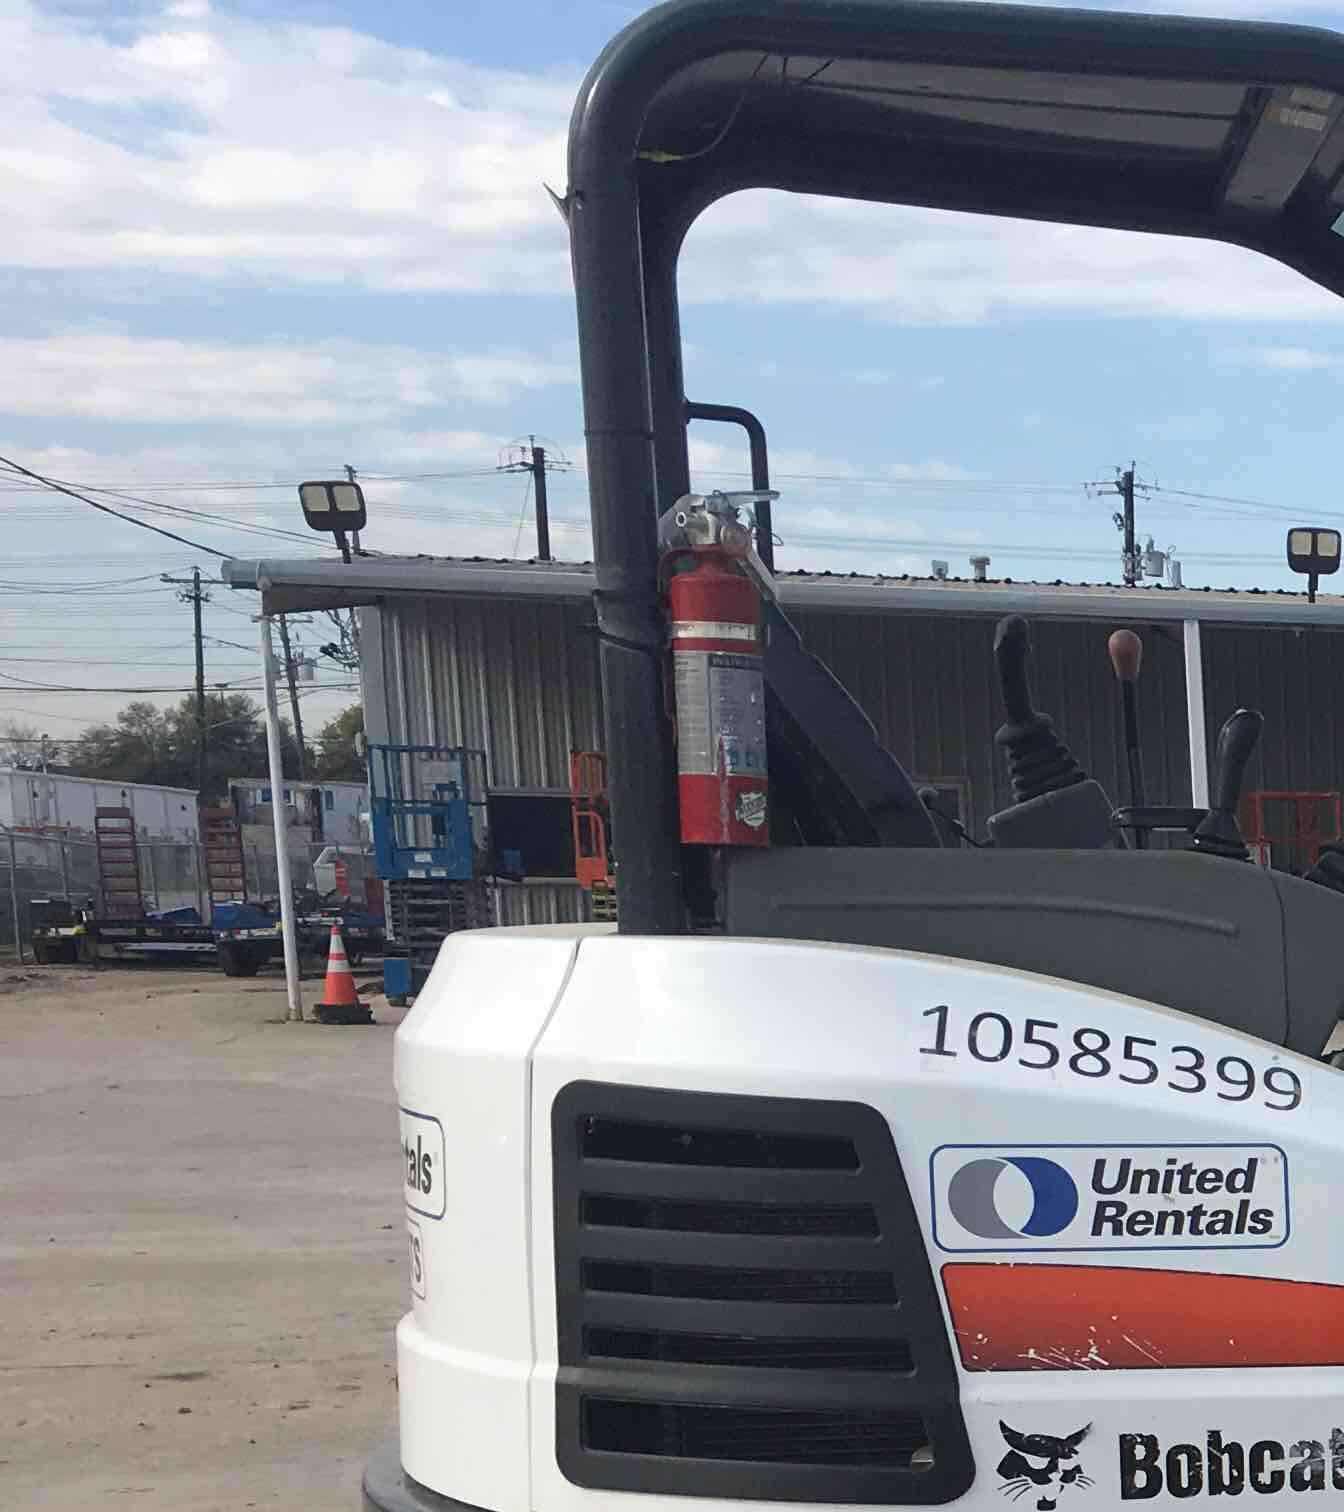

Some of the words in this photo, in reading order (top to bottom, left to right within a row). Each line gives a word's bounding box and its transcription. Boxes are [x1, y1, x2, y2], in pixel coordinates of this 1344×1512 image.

[919, 1005, 1302, 1111] 10585399
[1091, 1157, 1258, 1195] United
[1091, 1199, 1274, 1237] Rentals
